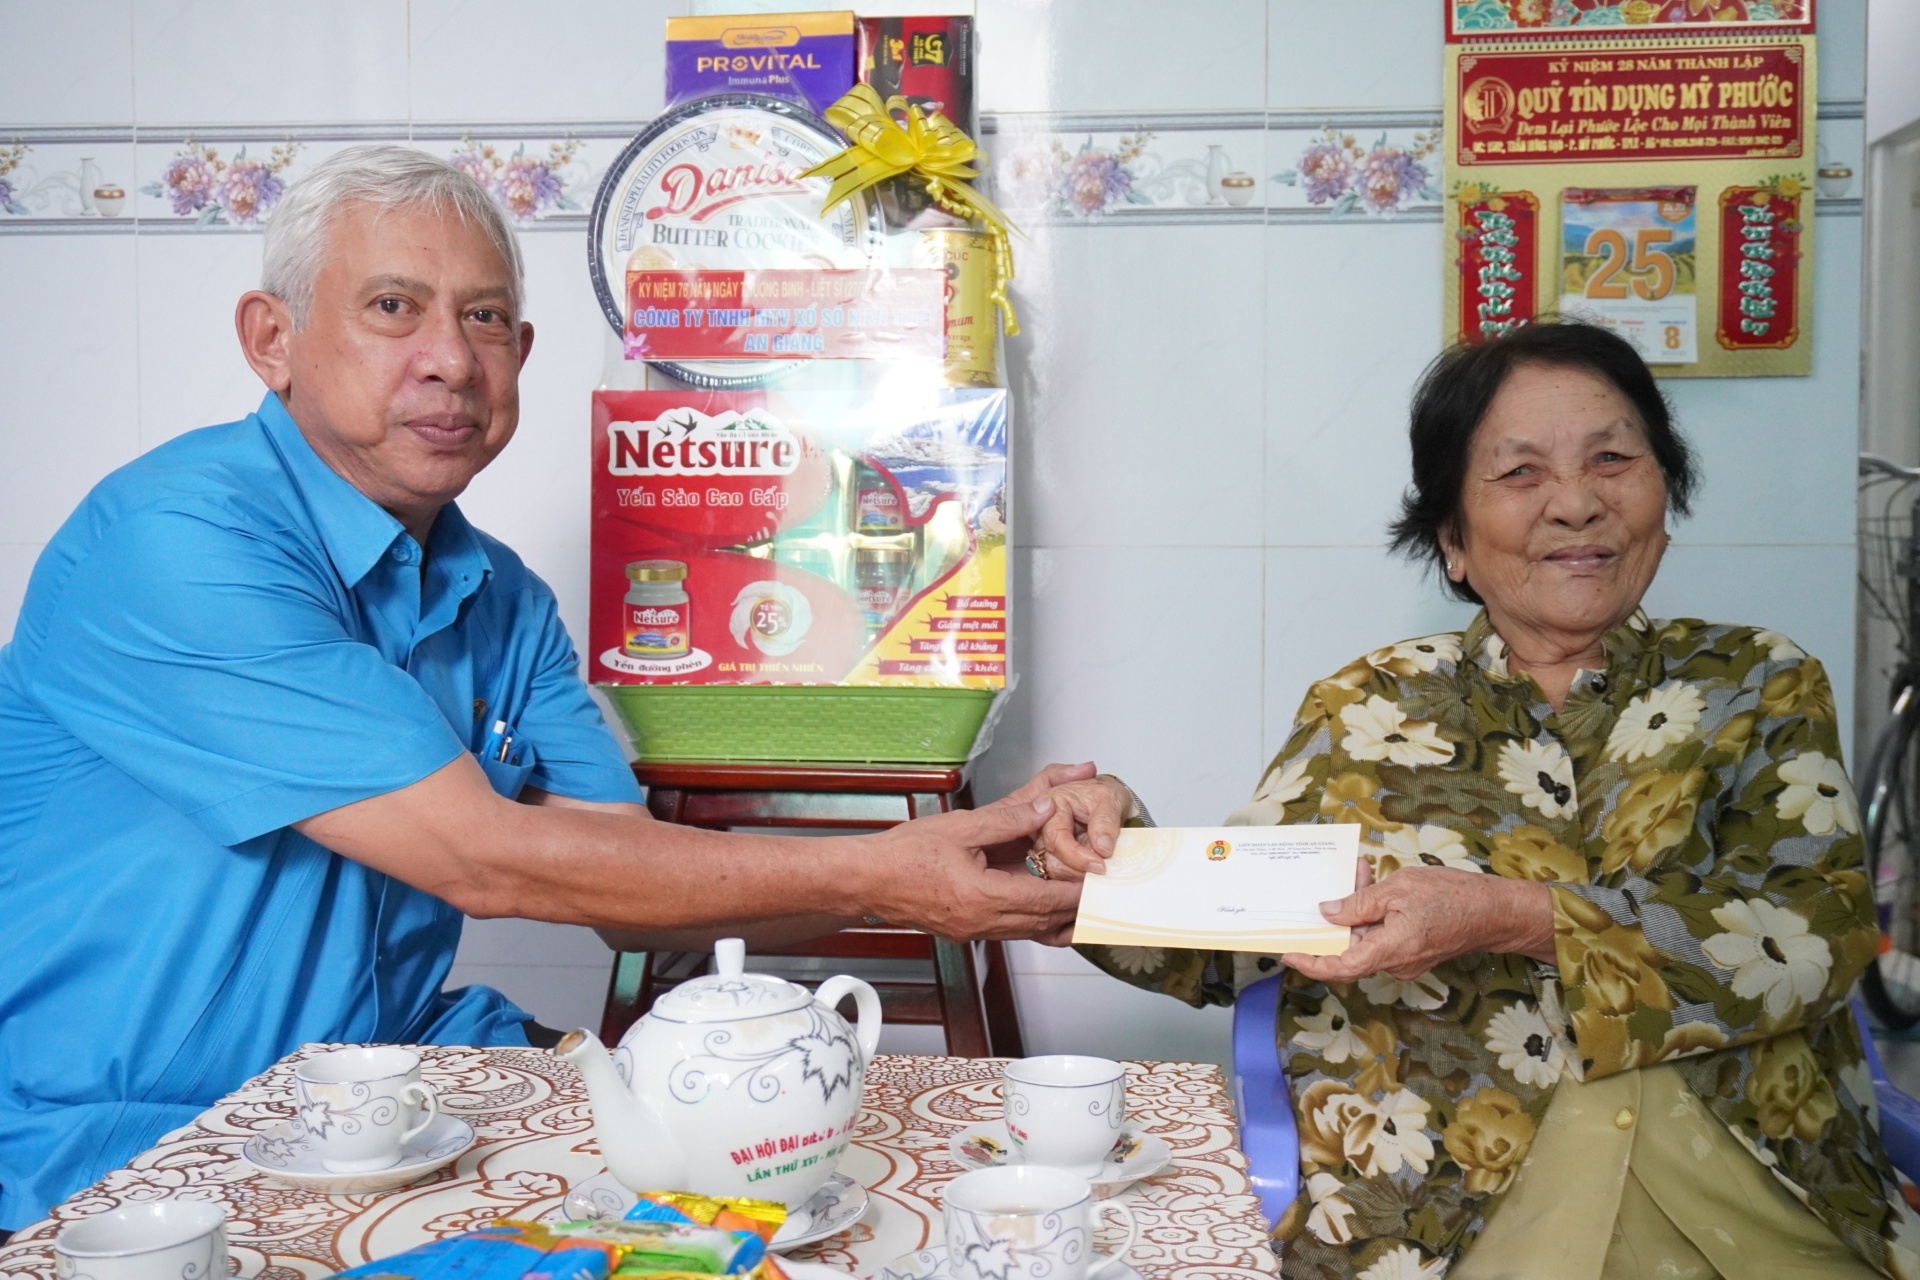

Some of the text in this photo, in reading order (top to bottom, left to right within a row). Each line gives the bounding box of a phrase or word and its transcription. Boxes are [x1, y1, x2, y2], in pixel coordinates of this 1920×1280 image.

[924, 34, 944, 64] G7
[697, 53, 821, 73] PROVITAL
[1573, 58, 1614, 74] NIỆM
[1636, 58, 1671, 71] NĂM
[1675, 55, 1729, 70] THÀNH
[768, 74, 790, 84] Plus
[1517, 73, 1794, 120] QUỸ TÍN DỤNG MỸ PHƯỚC
[1623, 117, 1649, 134] Lộc
[1651, 117, 1679, 132] Cho
[1681, 115, 1708, 133] Mọi
[1711, 114, 1757, 130] Thành
[1760, 113, 1792, 129] Viên
[618, 203, 634, 241] DANISH
[627, 157, 663, 204] SPECIALITY
[659, 136, 690, 160] FOODS
[652, 223, 728, 248] BUTTER
[1584, 228, 1677, 301] 25
[653, 278, 676, 301] NIỆM
[713, 278, 738, 298] NGÀY
[635, 306, 680, 327] CÔNG
[684, 309, 704, 327] TY
[707, 309, 751, 327] TNHH
[744, 333, 824, 352] AN GIANG
[1664, 325, 1681, 349] 8
[614, 430, 796, 469] Netsure
[617, 486, 790, 510] Yến Sào Cao Cấp
[862, 493, 897, 505] Netsure
[634, 611, 679, 624] Netsure
[970, 642, 998, 652] kháng
[614, 659, 703, 673] Yến đường phèn
[718, 661, 824, 673] GIÁ TRỊ THIÊN NHIÊN
[898, 662, 922, 673] Tăng
[730, 1147, 754, 1166] ĐẠI
[755, 1138, 777, 1159] HỘI
[779, 1134, 799, 1153] ĐẠI
